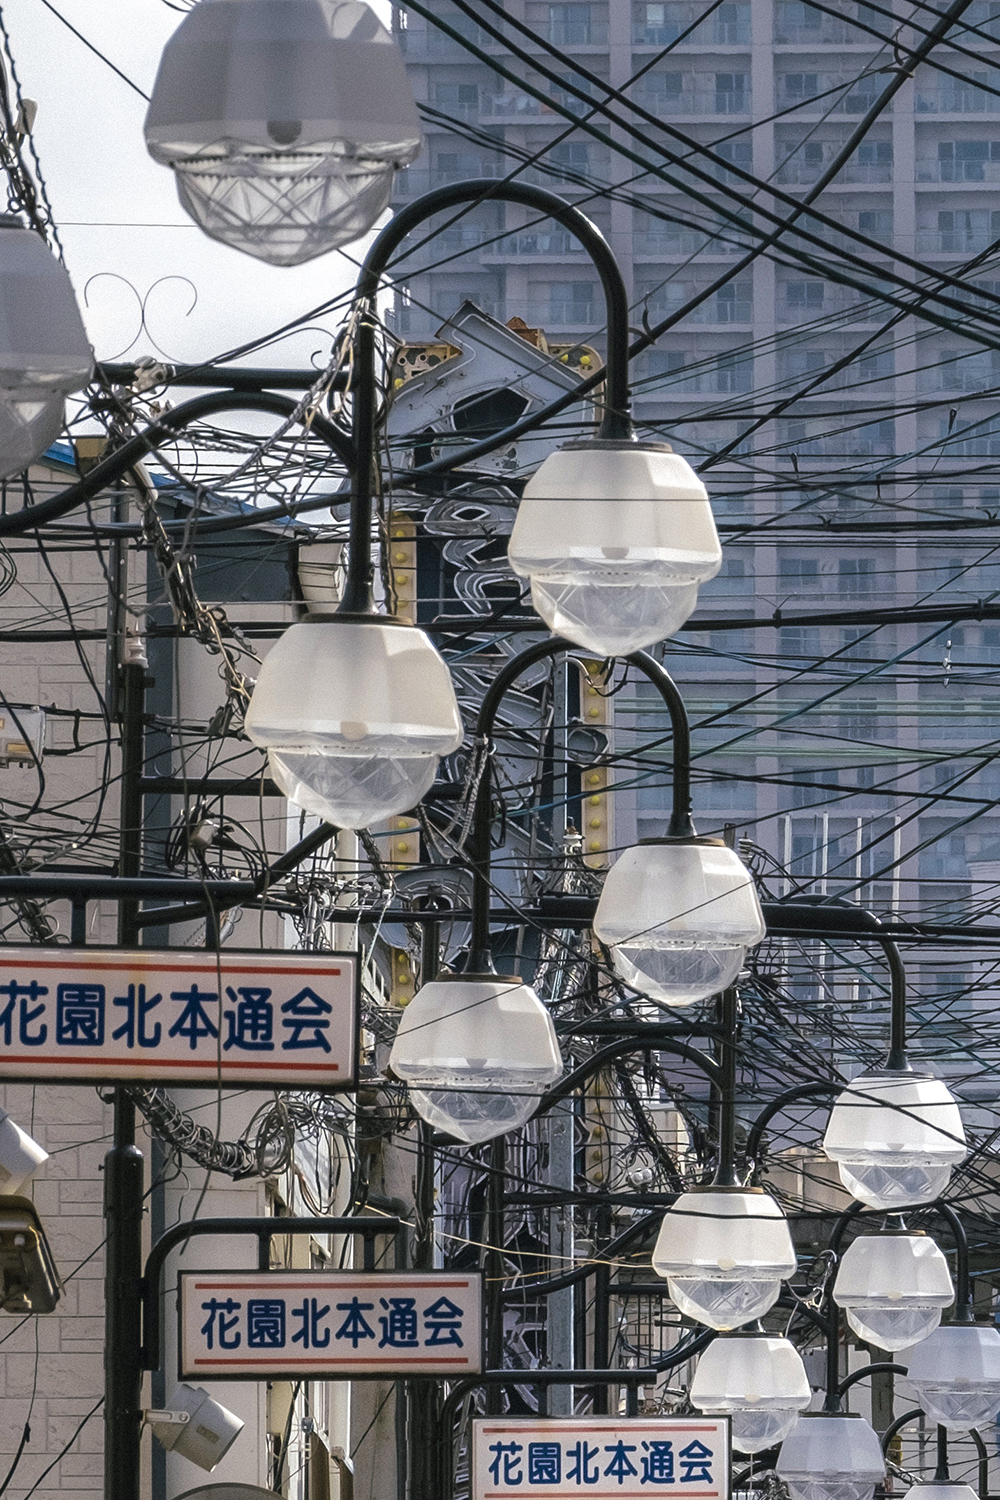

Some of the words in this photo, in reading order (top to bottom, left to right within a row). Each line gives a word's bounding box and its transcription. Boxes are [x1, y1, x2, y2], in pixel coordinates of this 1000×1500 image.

[0, 979, 333, 1053] 花園北本通会
[201, 1297, 465, 1351] 花園北本通会
[488, 1439, 715, 1487] 花園北本通会
